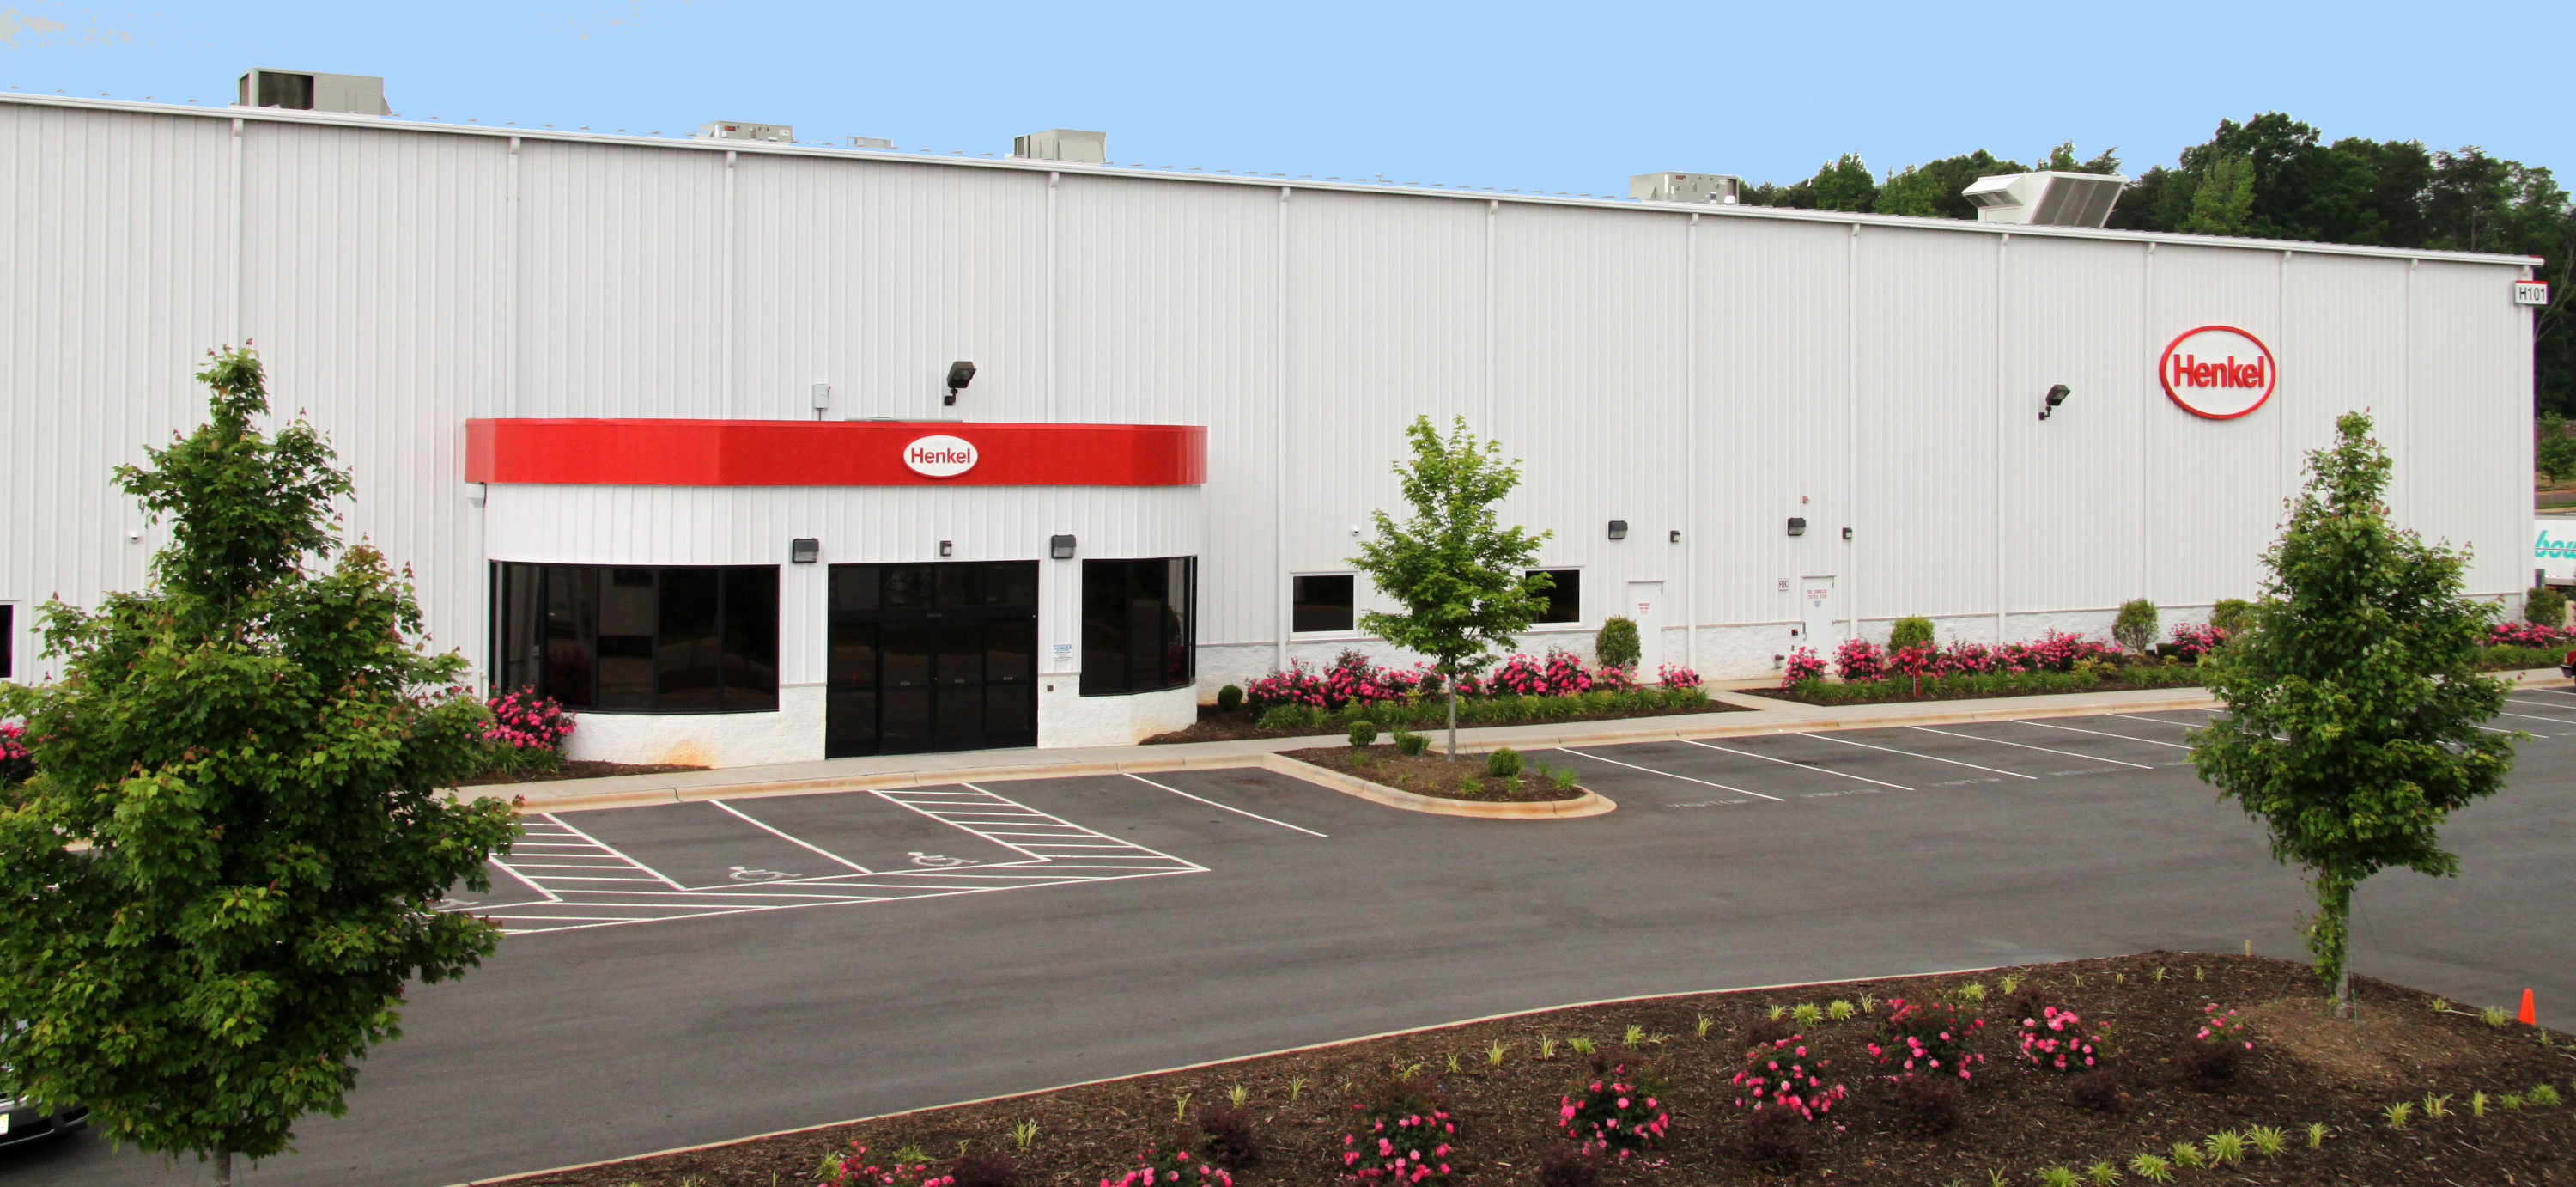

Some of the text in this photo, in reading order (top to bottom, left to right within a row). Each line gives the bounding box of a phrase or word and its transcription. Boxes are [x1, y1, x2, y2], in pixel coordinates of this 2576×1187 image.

[2518, 286, 2545, 301] H101
[2173, 354, 2265, 388] Henkel
[911, 447, 971, 464] Henkel
